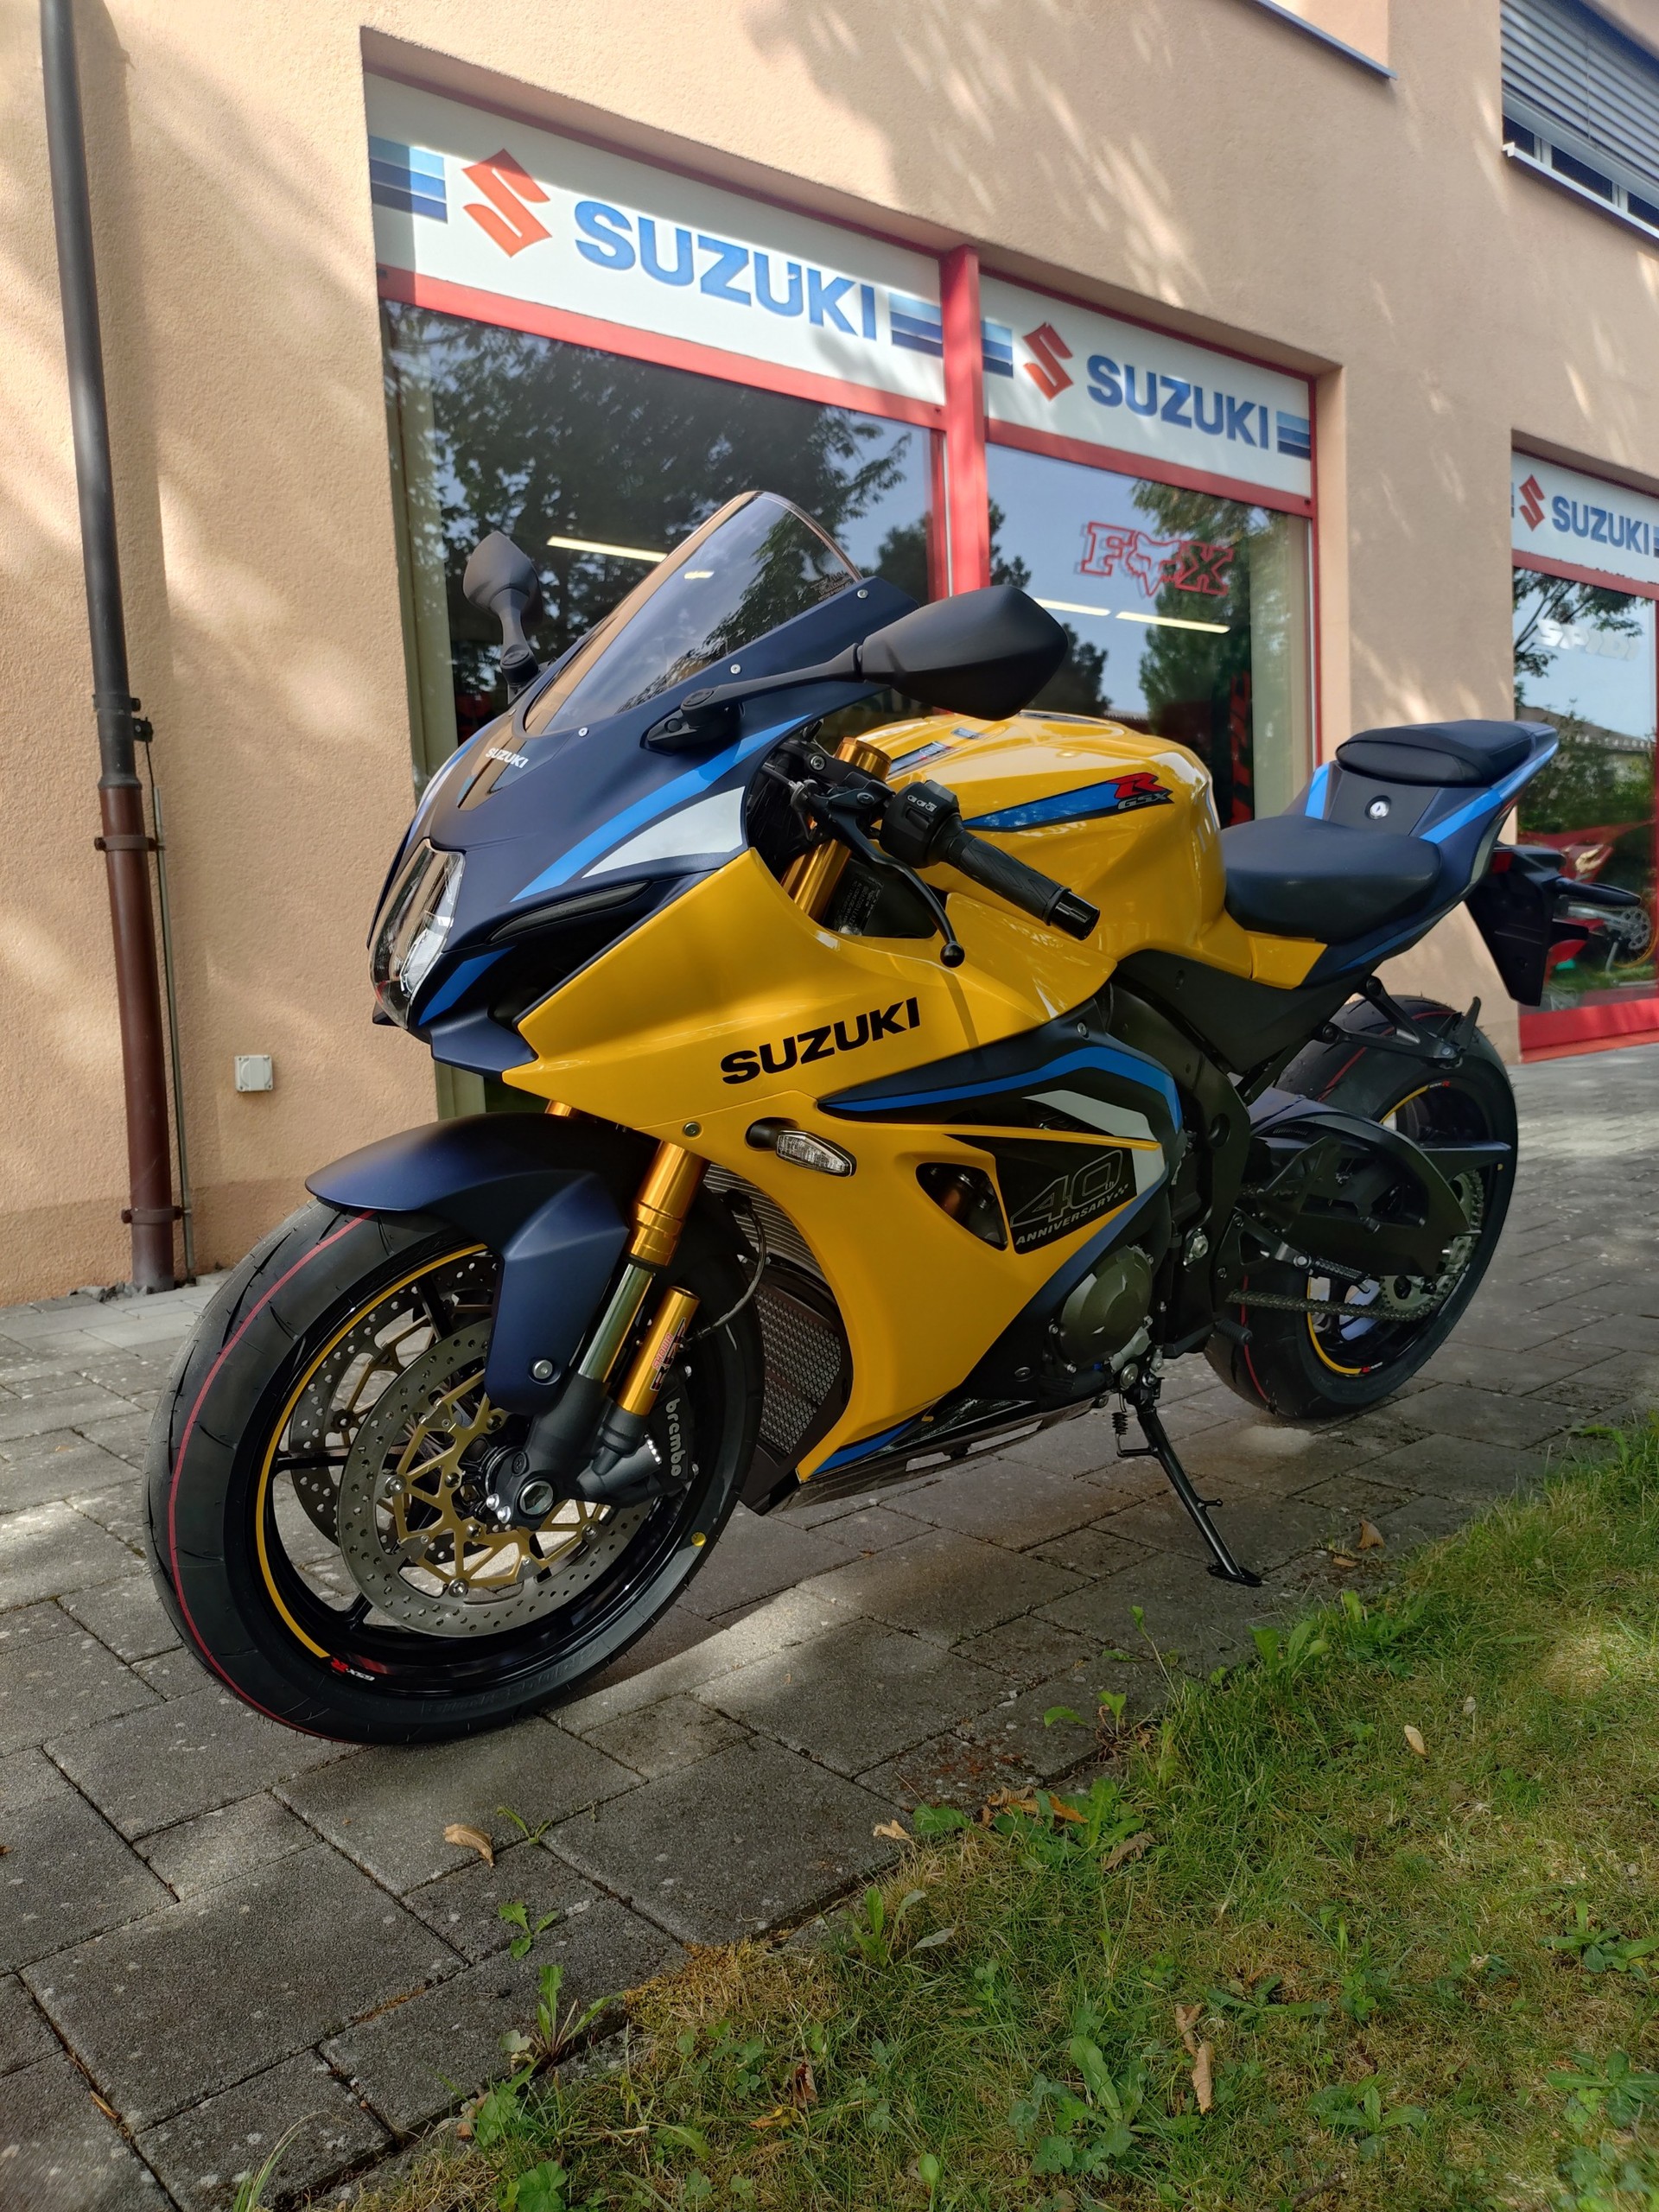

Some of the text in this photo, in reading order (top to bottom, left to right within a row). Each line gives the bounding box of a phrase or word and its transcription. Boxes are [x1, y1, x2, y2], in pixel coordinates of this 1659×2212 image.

[575, 200, 877, 341] SUZUKI
[1086, 354, 1270, 450] SUZUKI
[1551, 495, 1649, 556] SUZUKI
[485, 747, 530, 769] SUZUKI
[1117, 791, 1167, 810] GSX
[720, 996, 921, 1085] SUZUKI
[1014, 1192, 1118, 1246] ANNIVERSARY
[665, 1398, 686, 1477] brembo
